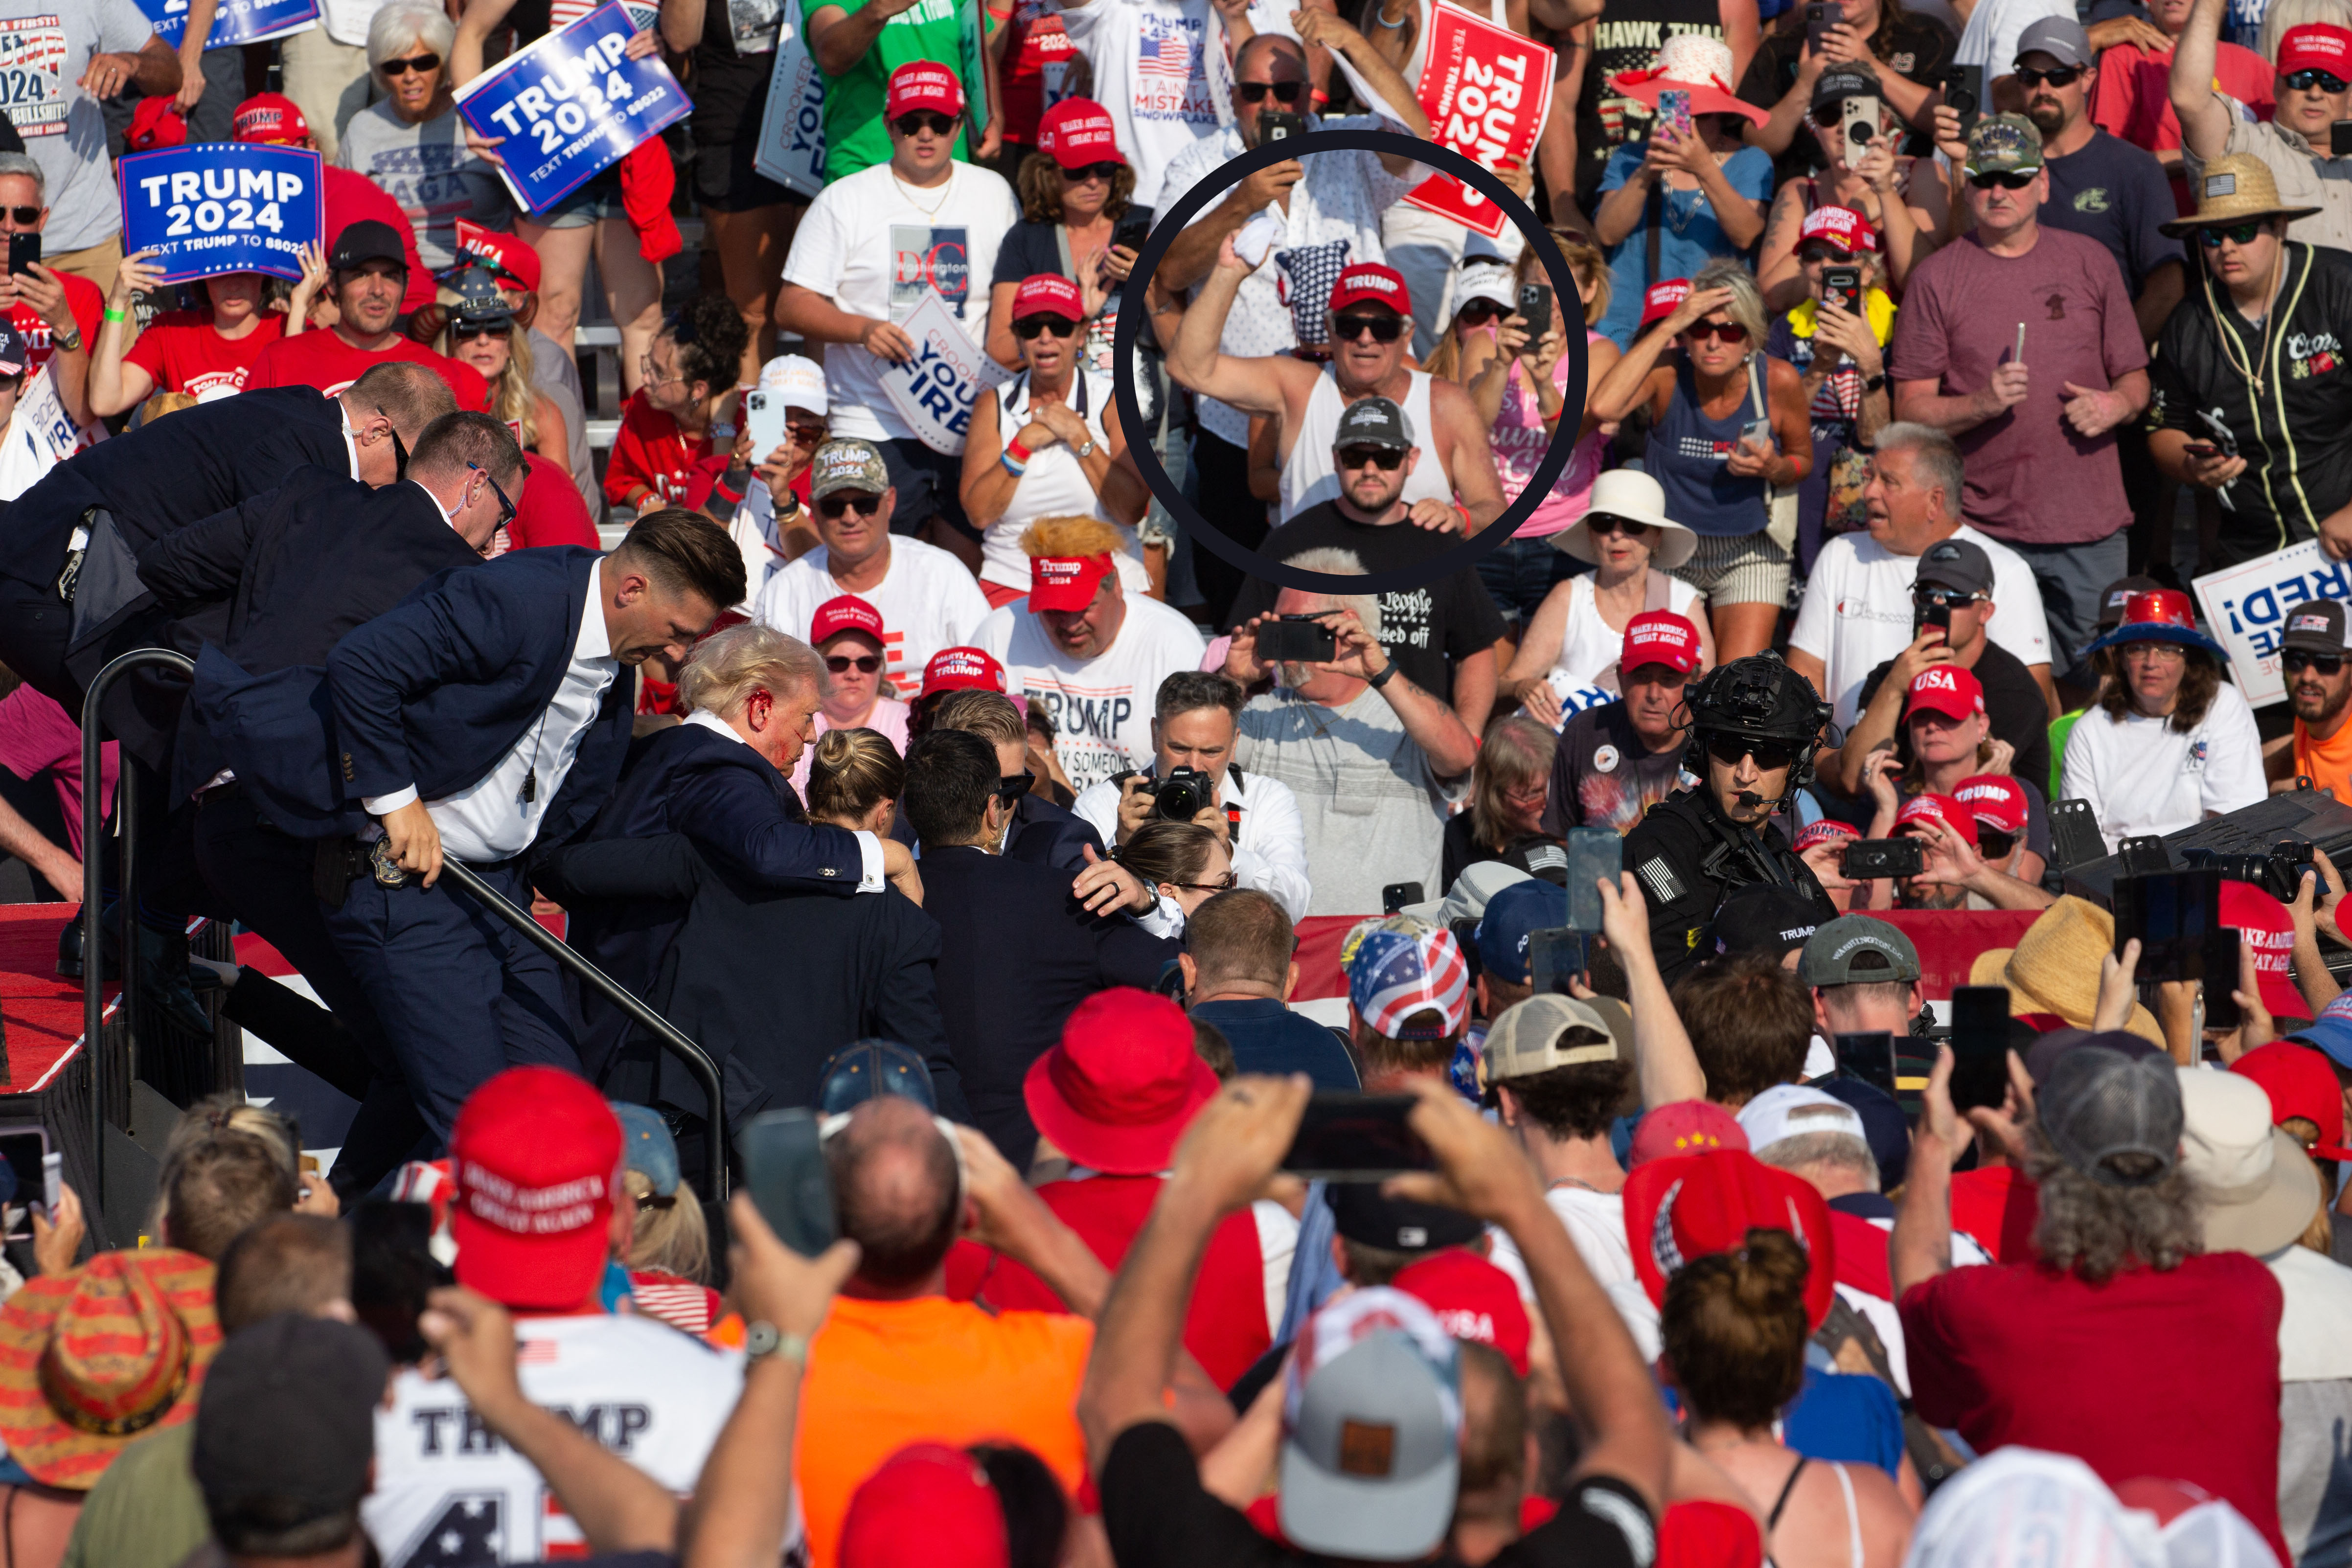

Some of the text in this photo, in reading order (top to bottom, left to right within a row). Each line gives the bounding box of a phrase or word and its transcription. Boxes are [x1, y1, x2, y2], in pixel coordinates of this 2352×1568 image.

[153, 16, 179, 33] EXT
[1143, 13, 1201, 30] TRUMP
[1451, 28, 1466, 64] TEXT
[1595, 21, 1663, 50] HAWK
[490, 32, 627, 136] TRUMP
[894, 71, 949, 89] MAKE AMERICA
[1438, 67, 1460, 116] TRUMP
[12, 102, 67, 125] BULLSHIT!
[531, 70, 633, 155] 2024
[779, 56, 813, 150] CROOKED
[1135, 93, 1217, 114] MISTAKE
[237, 112, 282, 129] TRUMP
[529, 154, 562, 183] TEXT
[562, 120, 610, 159] TRUMP
[627, 86, 667, 116] 88022
[140, 168, 303, 207] TRUMP
[166, 199, 284, 236] 2024
[1820, 205, 1858, 226] AMERICA
[1827, 217, 1853, 233] AGAIN
[183, 235, 237, 252] TRUMP
[241, 235, 262, 247] TO
[1345, 274, 1398, 293] TRUMP
[928, 328, 995, 390] CROOKE
[920, 339, 978, 406] YOU
[821, 449, 872, 465] TRUMP
[829, 464, 864, 477] 2024
[1039, 559, 1081, 574] Trump
[2223, 563, 2350, 635] RED!
[1410, 626, 1430, 649] off
[1630, 622, 1689, 639] MAKE AMERICA
[1633, 632, 1686, 647] GREAT AGAIN
[935, 652, 985, 665] MARYLAND
[935, 665, 983, 677] TRUMP
[1915, 669, 1957, 692] USA
[1024, 688, 1132, 740] TRUMP
[1073, 750, 1131, 775] SOMEONE
[1955, 785, 2010, 801] TRUMP
[1643, 874, 1655, 887] SECRET
[1653, 887, 1666, 903] SERVICE
[1780, 926, 1816, 941] TRUMP
[412, 1403, 651, 1456] TRMP
